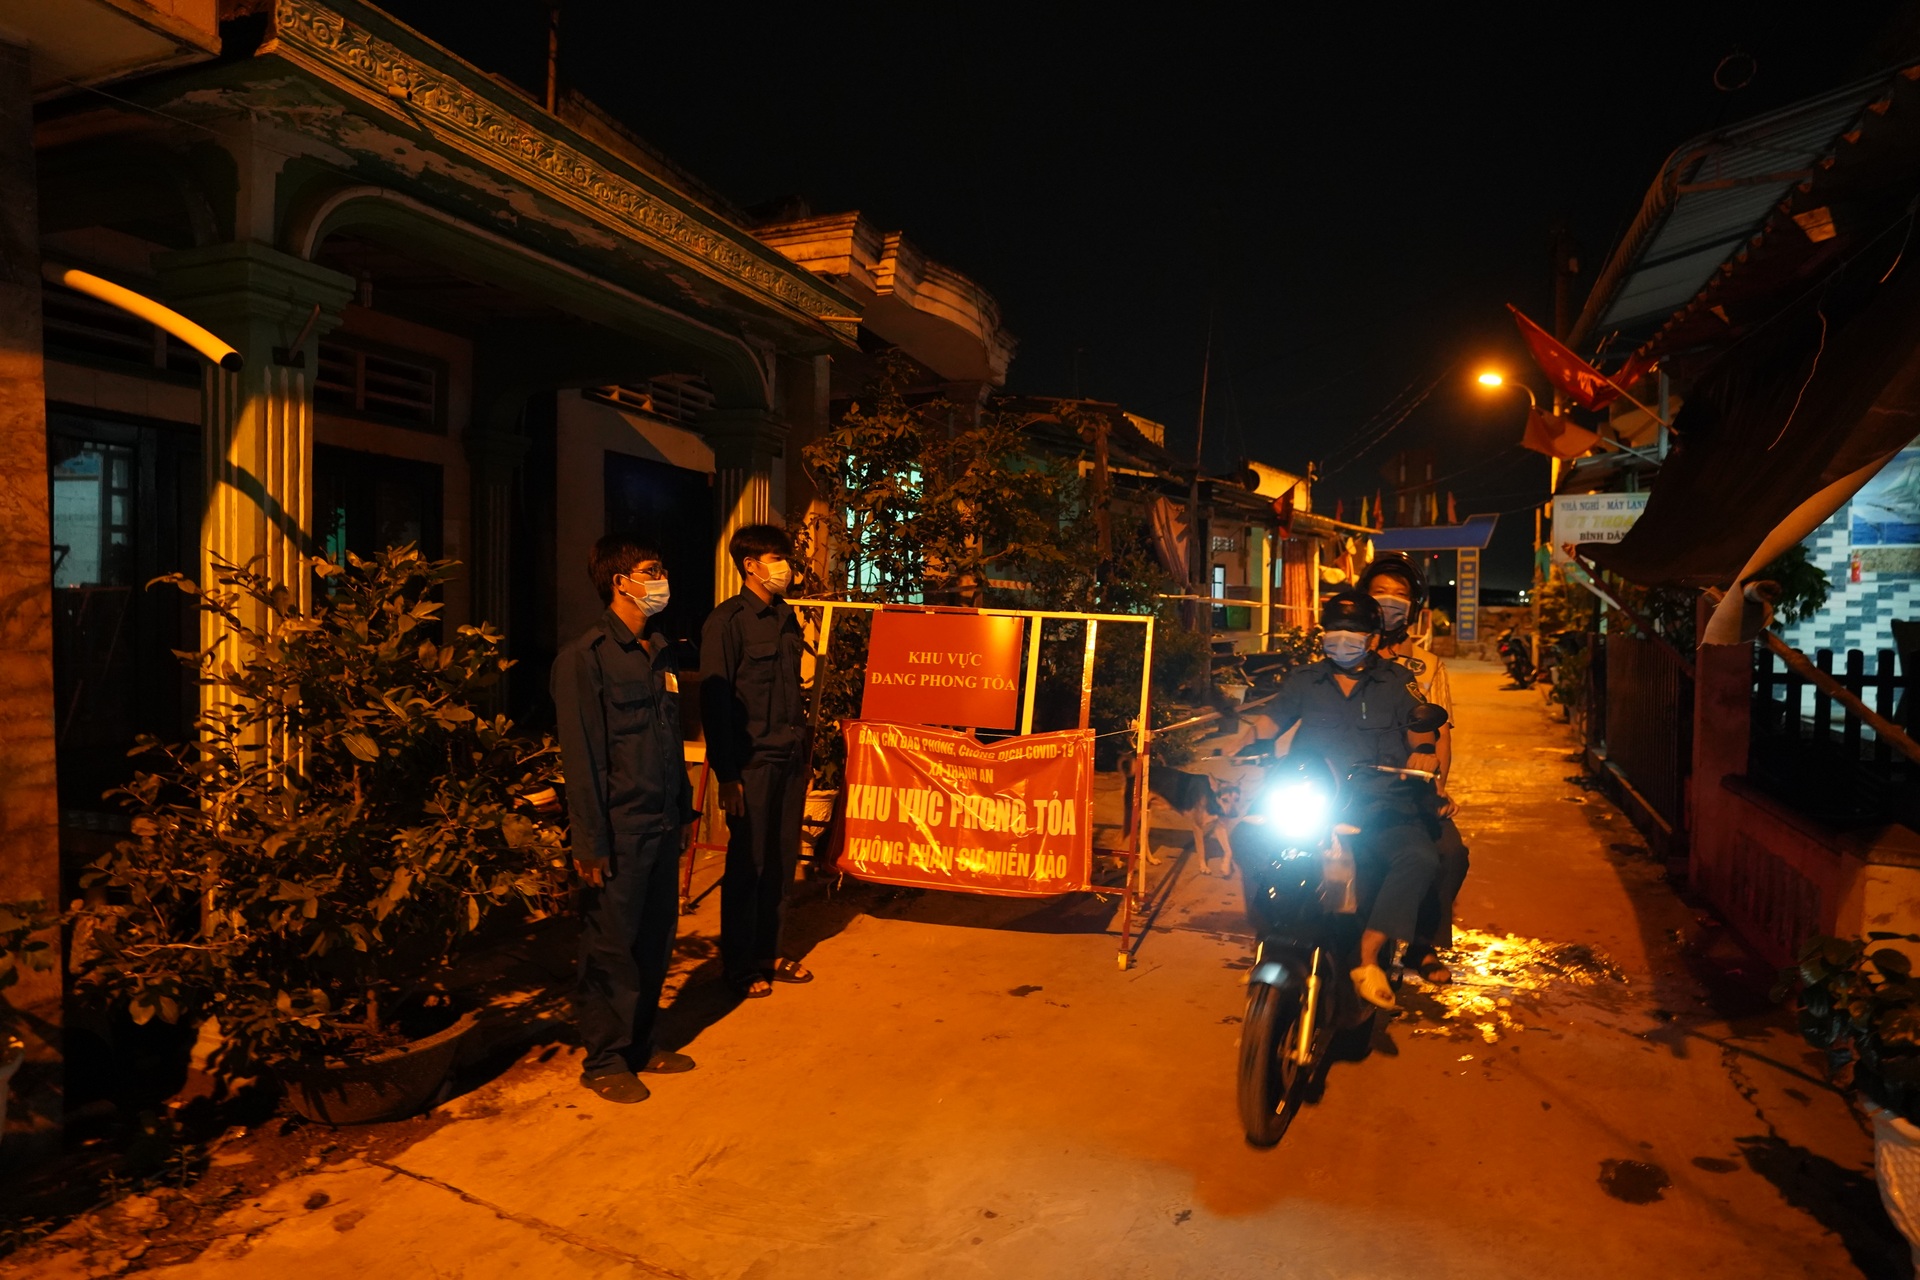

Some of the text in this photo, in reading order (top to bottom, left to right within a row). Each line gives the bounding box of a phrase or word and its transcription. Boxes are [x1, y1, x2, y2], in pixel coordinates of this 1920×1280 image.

[1607, 500, 1624, 511] MÁY
[1580, 531, 1603, 541] BÌNH
[908, 651, 983, 669] KHU VỰC
[871, 672, 1016, 691] ĐANG PHONG TỎA
[858, 730, 880, 746] BAN
[1026, 743, 1075, 760] COVID-19
[929, 760, 943, 777] XÃ
[979, 768, 994, 784] AN
[846, 783, 1077, 836] KHU VỰC PHONG TỎA
[848, 835, 904, 865] KHÔNG
[907, 841, 954, 874] PHẬN
[986, 844, 1030, 877] MIỄN
[1034, 849, 1067, 880] VÀO
